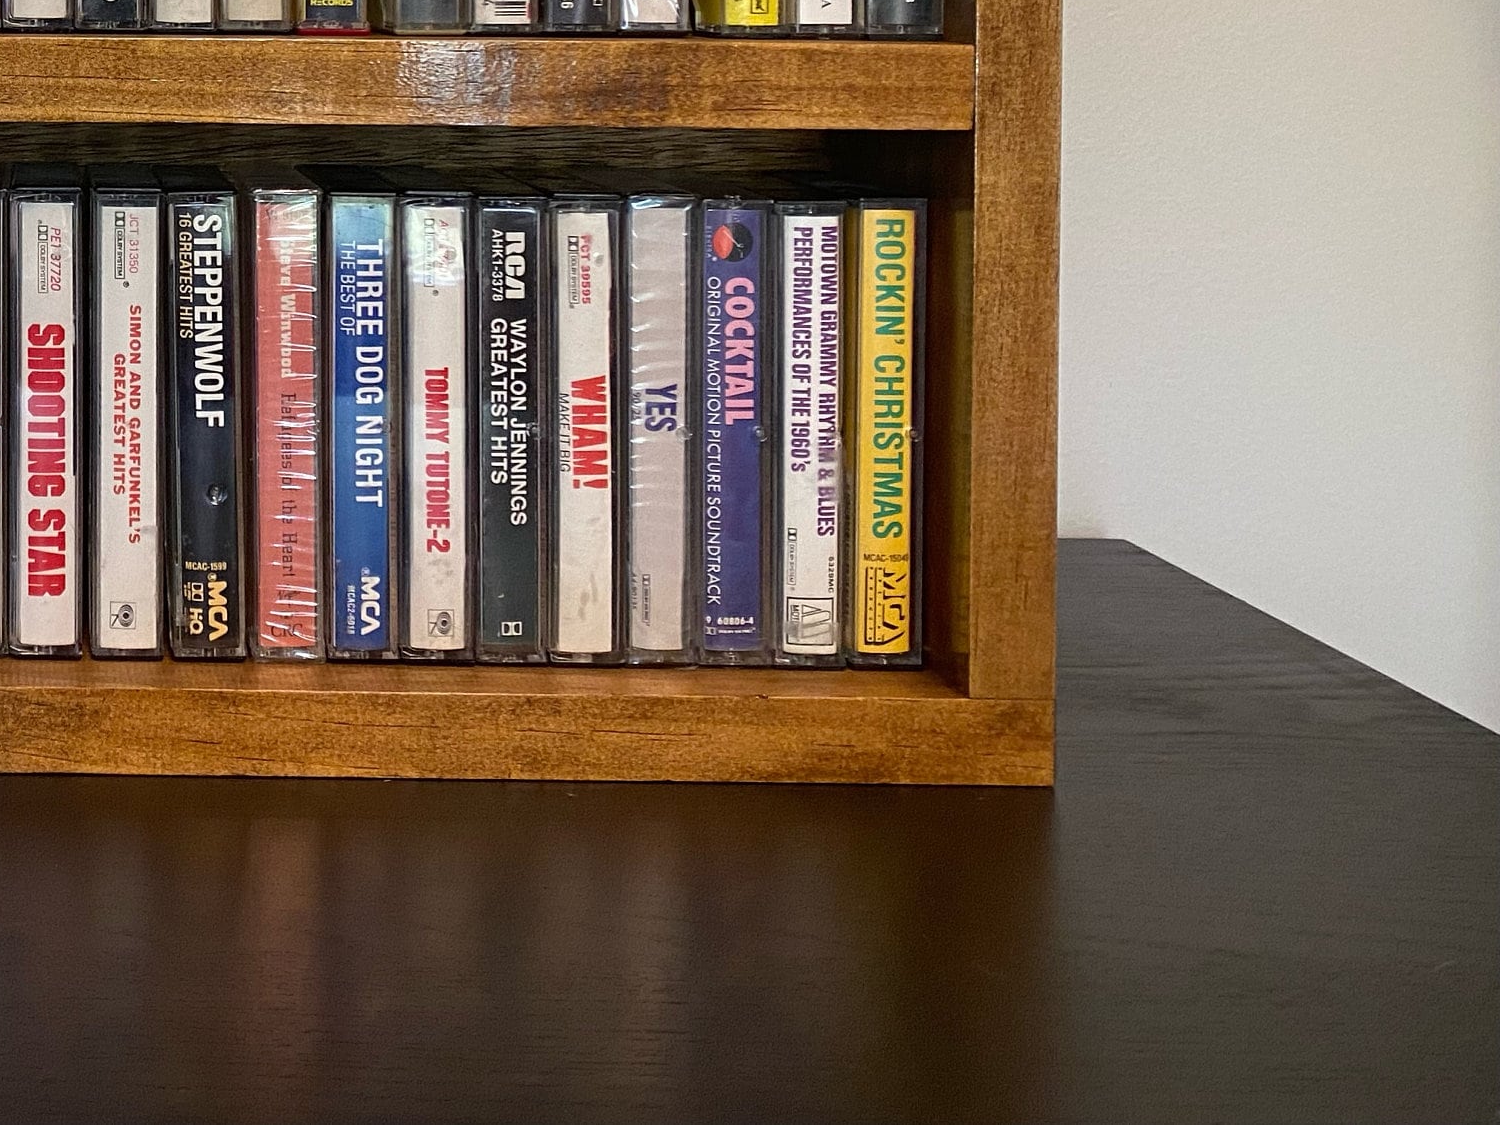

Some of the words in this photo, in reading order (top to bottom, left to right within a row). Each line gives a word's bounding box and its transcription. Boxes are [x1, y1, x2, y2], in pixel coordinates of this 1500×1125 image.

[180, 212, 191, 228] 16
[180, 232, 192, 302] GREATEST
[356, 239, 383, 335] THREE
[491, 229, 503, 301] AHK1-3378
[505, 233, 525, 299] RCA
[792, 226, 811, 359] PERFORMANCES
[874, 219, 905, 345] ROCKIN'
[129, 305, 141, 364] SIMON
[180, 306, 193, 338] HITS
[193, 215, 224, 426] STEPPENWOLF
[706, 277, 721, 355] ORIGINAL
[725, 278, 754, 425] COCKTAIL
[129, 371, 141, 409] AND
[356, 346, 382, 404] DOG
[510, 319, 526, 409] WAYLON
[706, 359, 721, 425] MOTION
[792, 364, 810, 384] OF
[28, 324, 66, 497] SHOOTING
[425, 368, 449, 442] TOMMY
[571, 375, 607, 489] WHAM!
[645, 385, 677, 432] YES
[792, 388, 810, 416] THE
[128, 417, 140, 544] GARFUNKEL'S
[356, 416, 382, 507] NIGHT
[509, 417, 526, 525] JENNINGS
[707, 430, 720, 492] PICTURE
[792, 421, 810, 471] 1960's
[872, 355, 904, 538] CHRISTMAS
[426, 452, 449, 553] TUTONE-2
[28, 509, 66, 596] STAR
[706, 497, 720, 604] SOUNDTRACK
[208, 581, 227, 641] MCA
[360, 576, 380, 635] MCA
